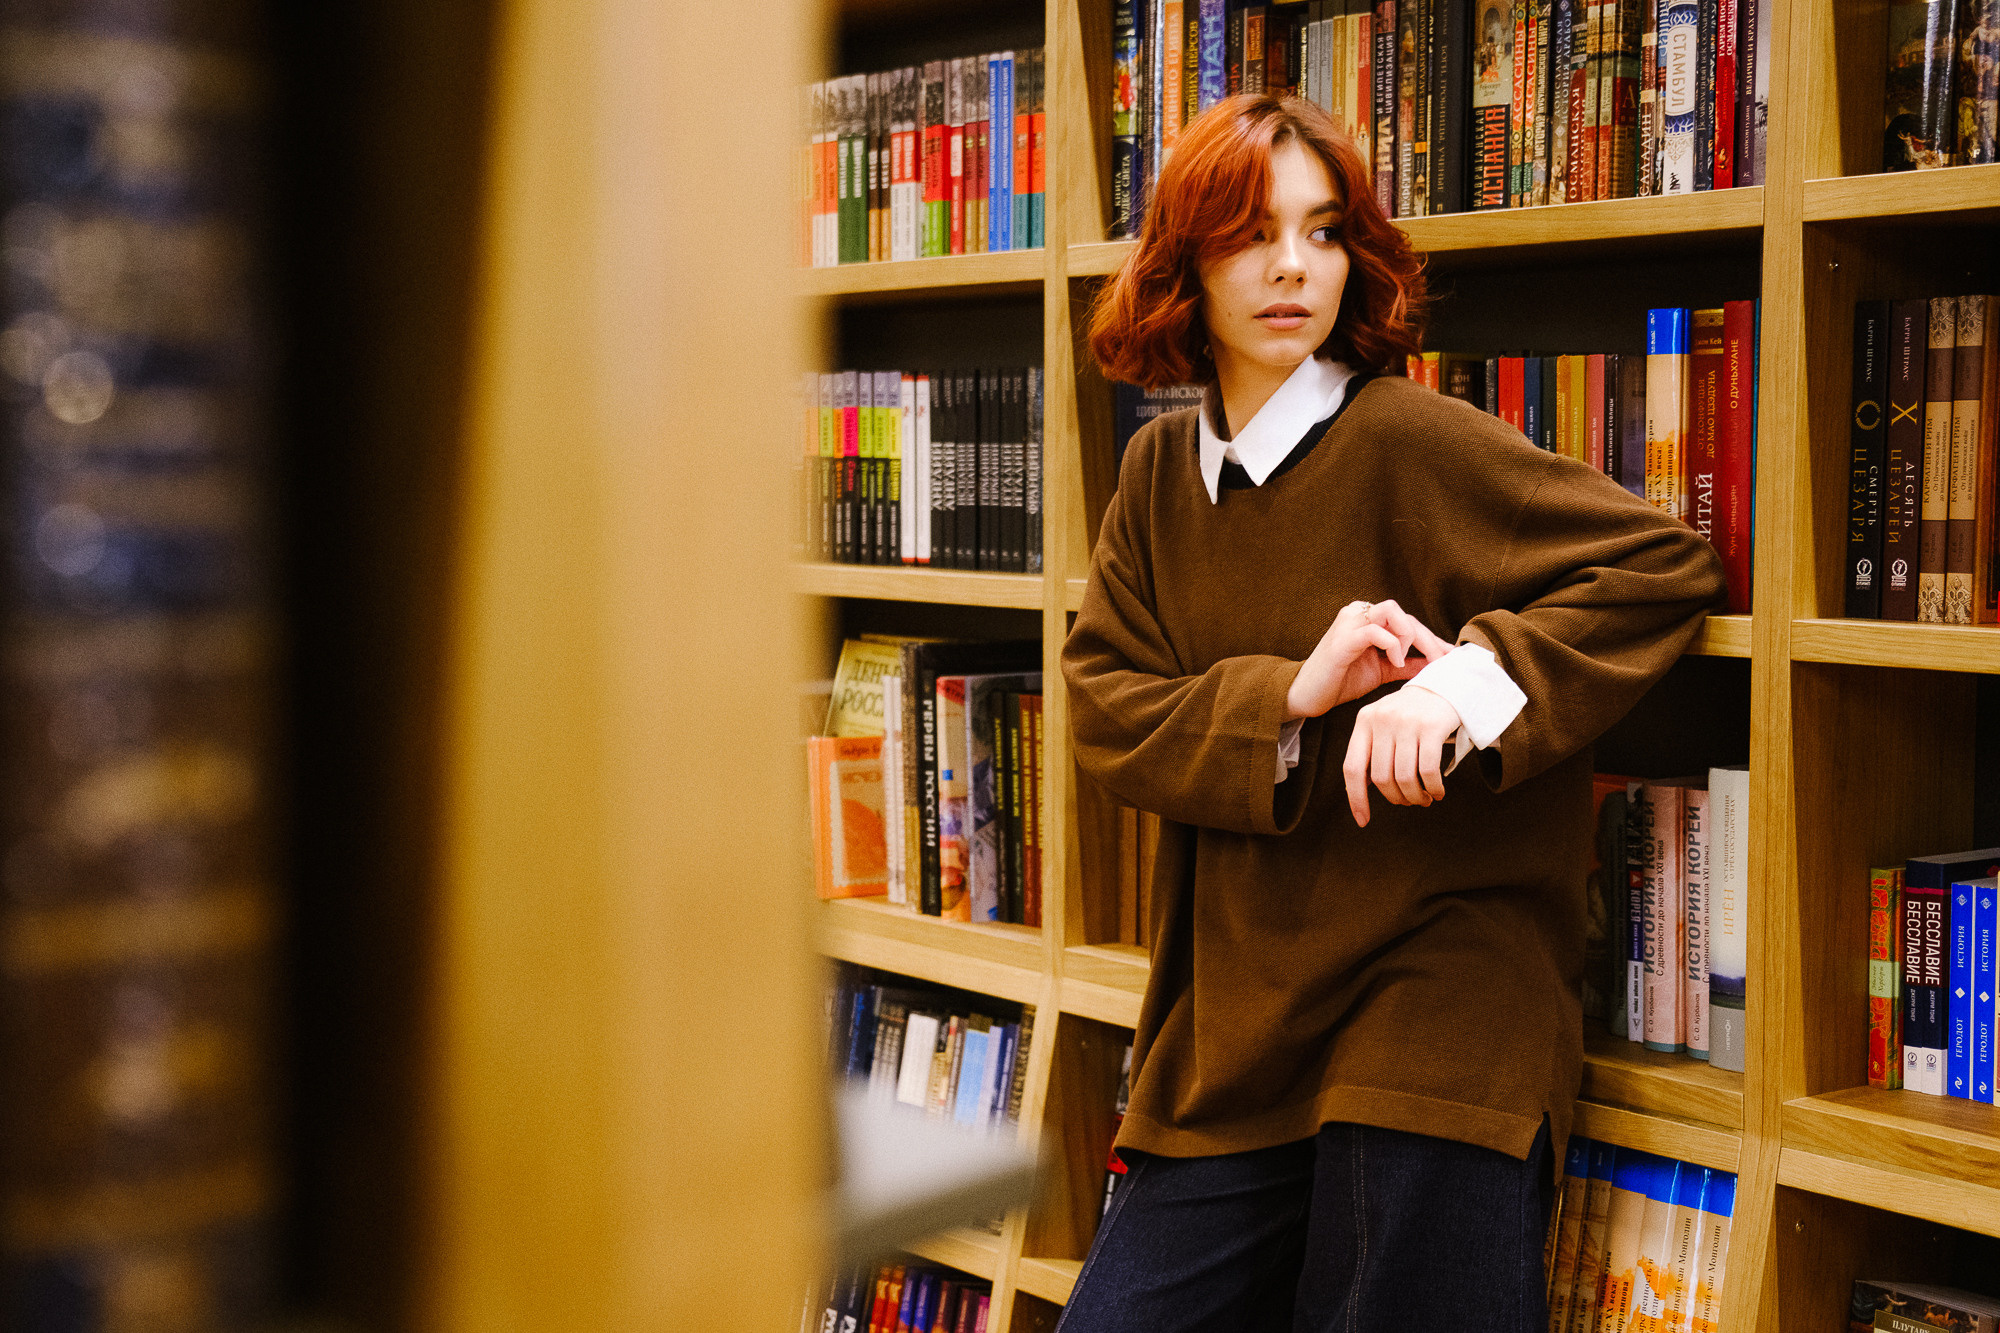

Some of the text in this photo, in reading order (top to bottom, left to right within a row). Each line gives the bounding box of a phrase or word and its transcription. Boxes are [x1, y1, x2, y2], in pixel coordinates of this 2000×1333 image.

[1718, 24, 1727, 58] ГАРЕМ
[1747, 16, 1756, 43] КРАХ
[1187, 21, 1199, 121] РЕВНИХ ПЕРСОВ
[1376, 36, 1385, 103] ЕГИПЕТСКАЯ
[1385, 34, 1395, 114] ЦИВИЛИЗАЦИЯ
[1418, 52, 1427, 96] ЗАГАДКИ
[1513, 29, 1525, 123] АССАСИНЫ
[1526, 26, 1537, 120] АССАСИНЫ
[1535, 18, 1549, 158] ИСТОРИЯ МУСУЛЬМАНСКОГО МИРА
[1553, 20, 1563, 117] ДОИСЛАМСКАЯ
[1560, 10, 1572, 123] ИСТОРИЯ АРАБОВ
[1671, 32, 1688, 107] СТАМБУЛ
[1744, 51, 1754, 96] ВЕЛИЧИЕ
[1167, 68, 1180, 139] ДРЕВНЕГО
[1120, 153, 1131, 188] СВЕТА
[1376, 116, 1394, 171] НИЛ
[1473, 106, 1484, 208] МАВРИТАНСКАЯ
[1482, 105, 1506, 206] ИСПАНИЯ
[1569, 87, 1580, 199] ОСМАНСКАЯ
[1639, 113, 1654, 197] САЛАДИН
[1865, 319, 1874, 383] БАРРИ ШТРАУС
[1901, 316, 1912, 382] БАРРИ ШТРАУС
[1696, 379, 1707, 451] ОТ КОНФУЦИЯ
[1706, 370, 1717, 459] ДО МАО ЦЗЭДУНА
[1727, 338, 1740, 558] Жун Синьцзян О ДУНЬХУАНЕ
[1923, 417, 1934, 441] РИМ
[1952, 416, 1963, 440] РИМ
[1851, 447, 1867, 543] ЦЕЗАРЯ
[1867, 464, 1879, 527] СМЕРТЬ
[1888, 449, 1902, 544] ЦЕЗАРЕЙ
[1904, 461, 1915, 528] ДЕСЯТЬ
[1923, 453, 1934, 504] КАРФАГЕН
[1951, 452, 1962, 503] КАРФАГЕН
[1657, 840, 1665, 861] века
[1688, 805, 1701, 875] КОРЕИ
[1630, 889, 1643, 922] КОРЕЯ
[1643, 874, 1655, 974] ИСТОРИЯ
[1657, 876, 1665, 908] начала
[1657, 909, 1665, 921] до
[1722, 888, 1736, 936] ИРЁН
[1656, 922, 1666, 969] древности
[1687, 881, 1701, 981] ИСТОРИЯ
[1906, 900, 1922, 984] БЕССЛАВИЕ
[1925, 901, 1941, 985] БЕССЛАВИЕ
[1693, 993, 1701, 1025] Курбанов
[1954, 925, 1965, 1058] ГЕРОДОТ ИСТОРИЯ
[1979, 928, 1990, 1063] ГЕРОДОТ ИСТОРИЯ
[1571, 1148, 1581, 1165] 2
[1669, 1217, 1693, 1325] великий хан Монголии
[1708, 1224, 1723, 1272] Монголии
[1610, 1280, 1618, 1304] века:
[1707, 1275, 1716, 1292] хан
